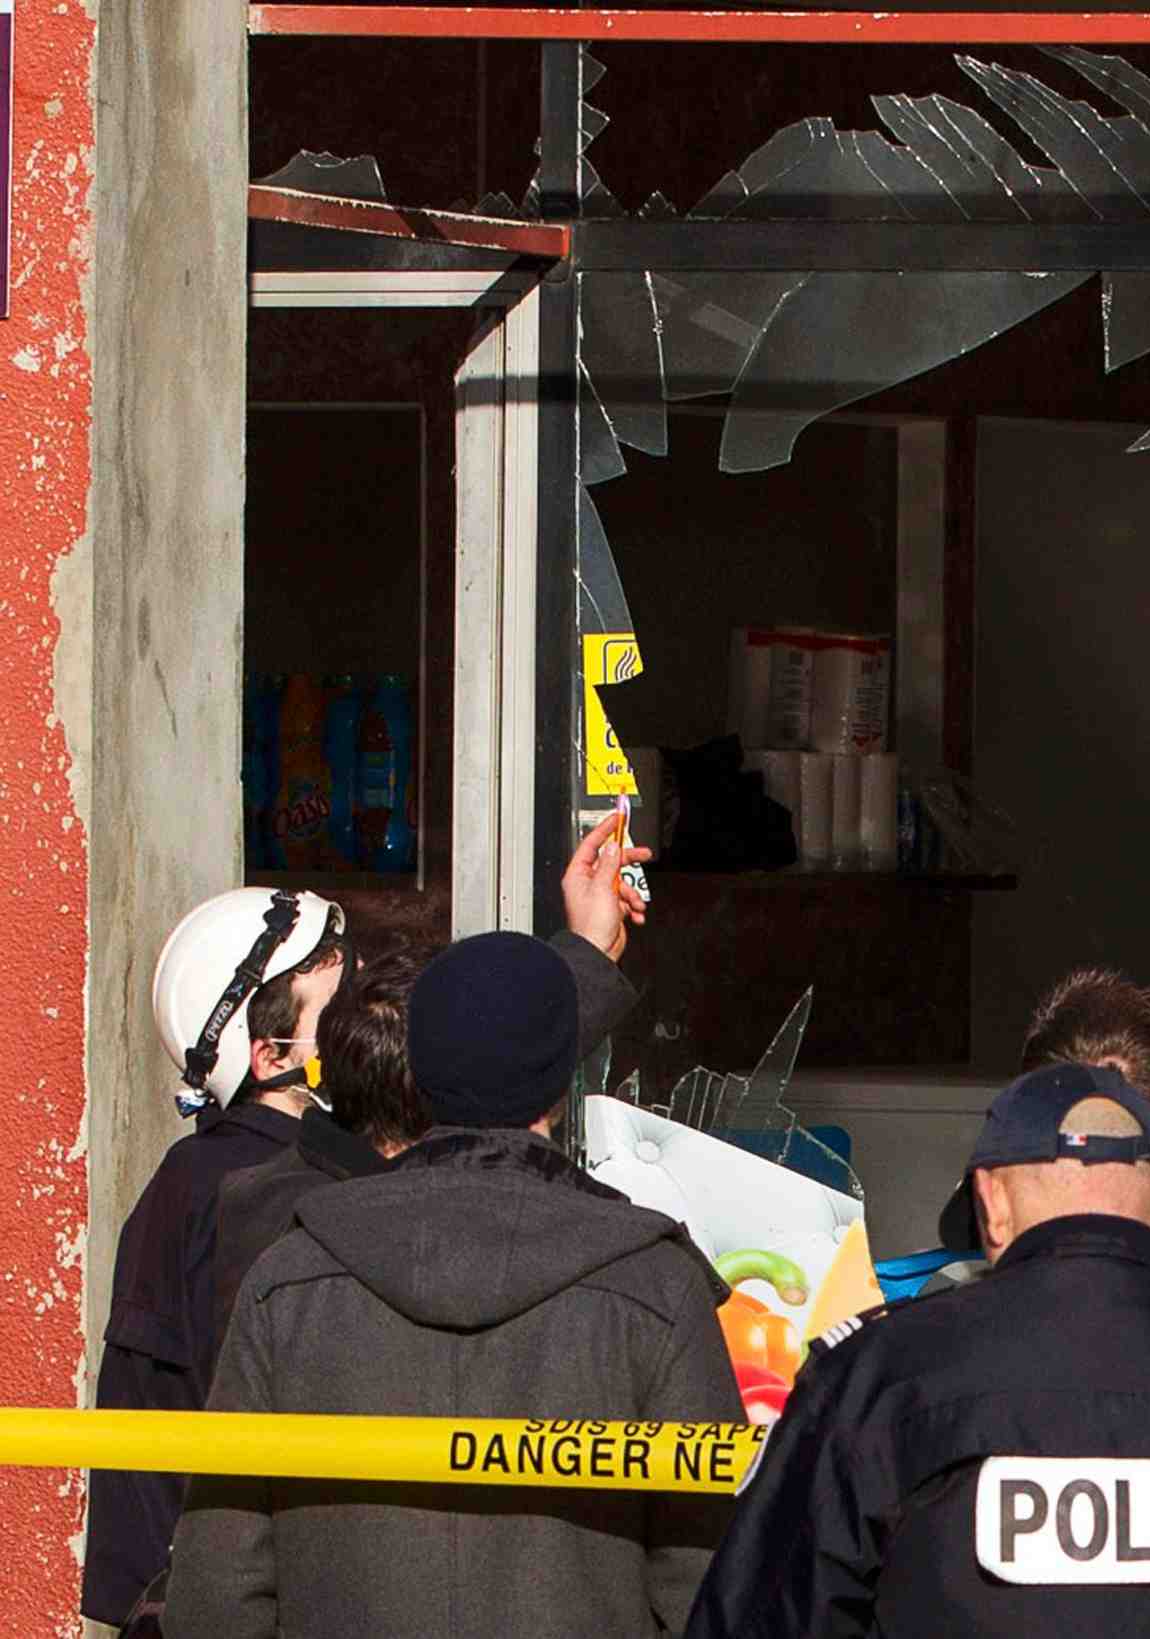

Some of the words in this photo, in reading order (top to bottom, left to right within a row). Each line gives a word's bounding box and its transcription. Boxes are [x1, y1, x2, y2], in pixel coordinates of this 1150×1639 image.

[677, 1422, 768, 1442] SAPE
[450, 1432, 650, 1480] DANGER
[674, 1442, 736, 1482] NE
